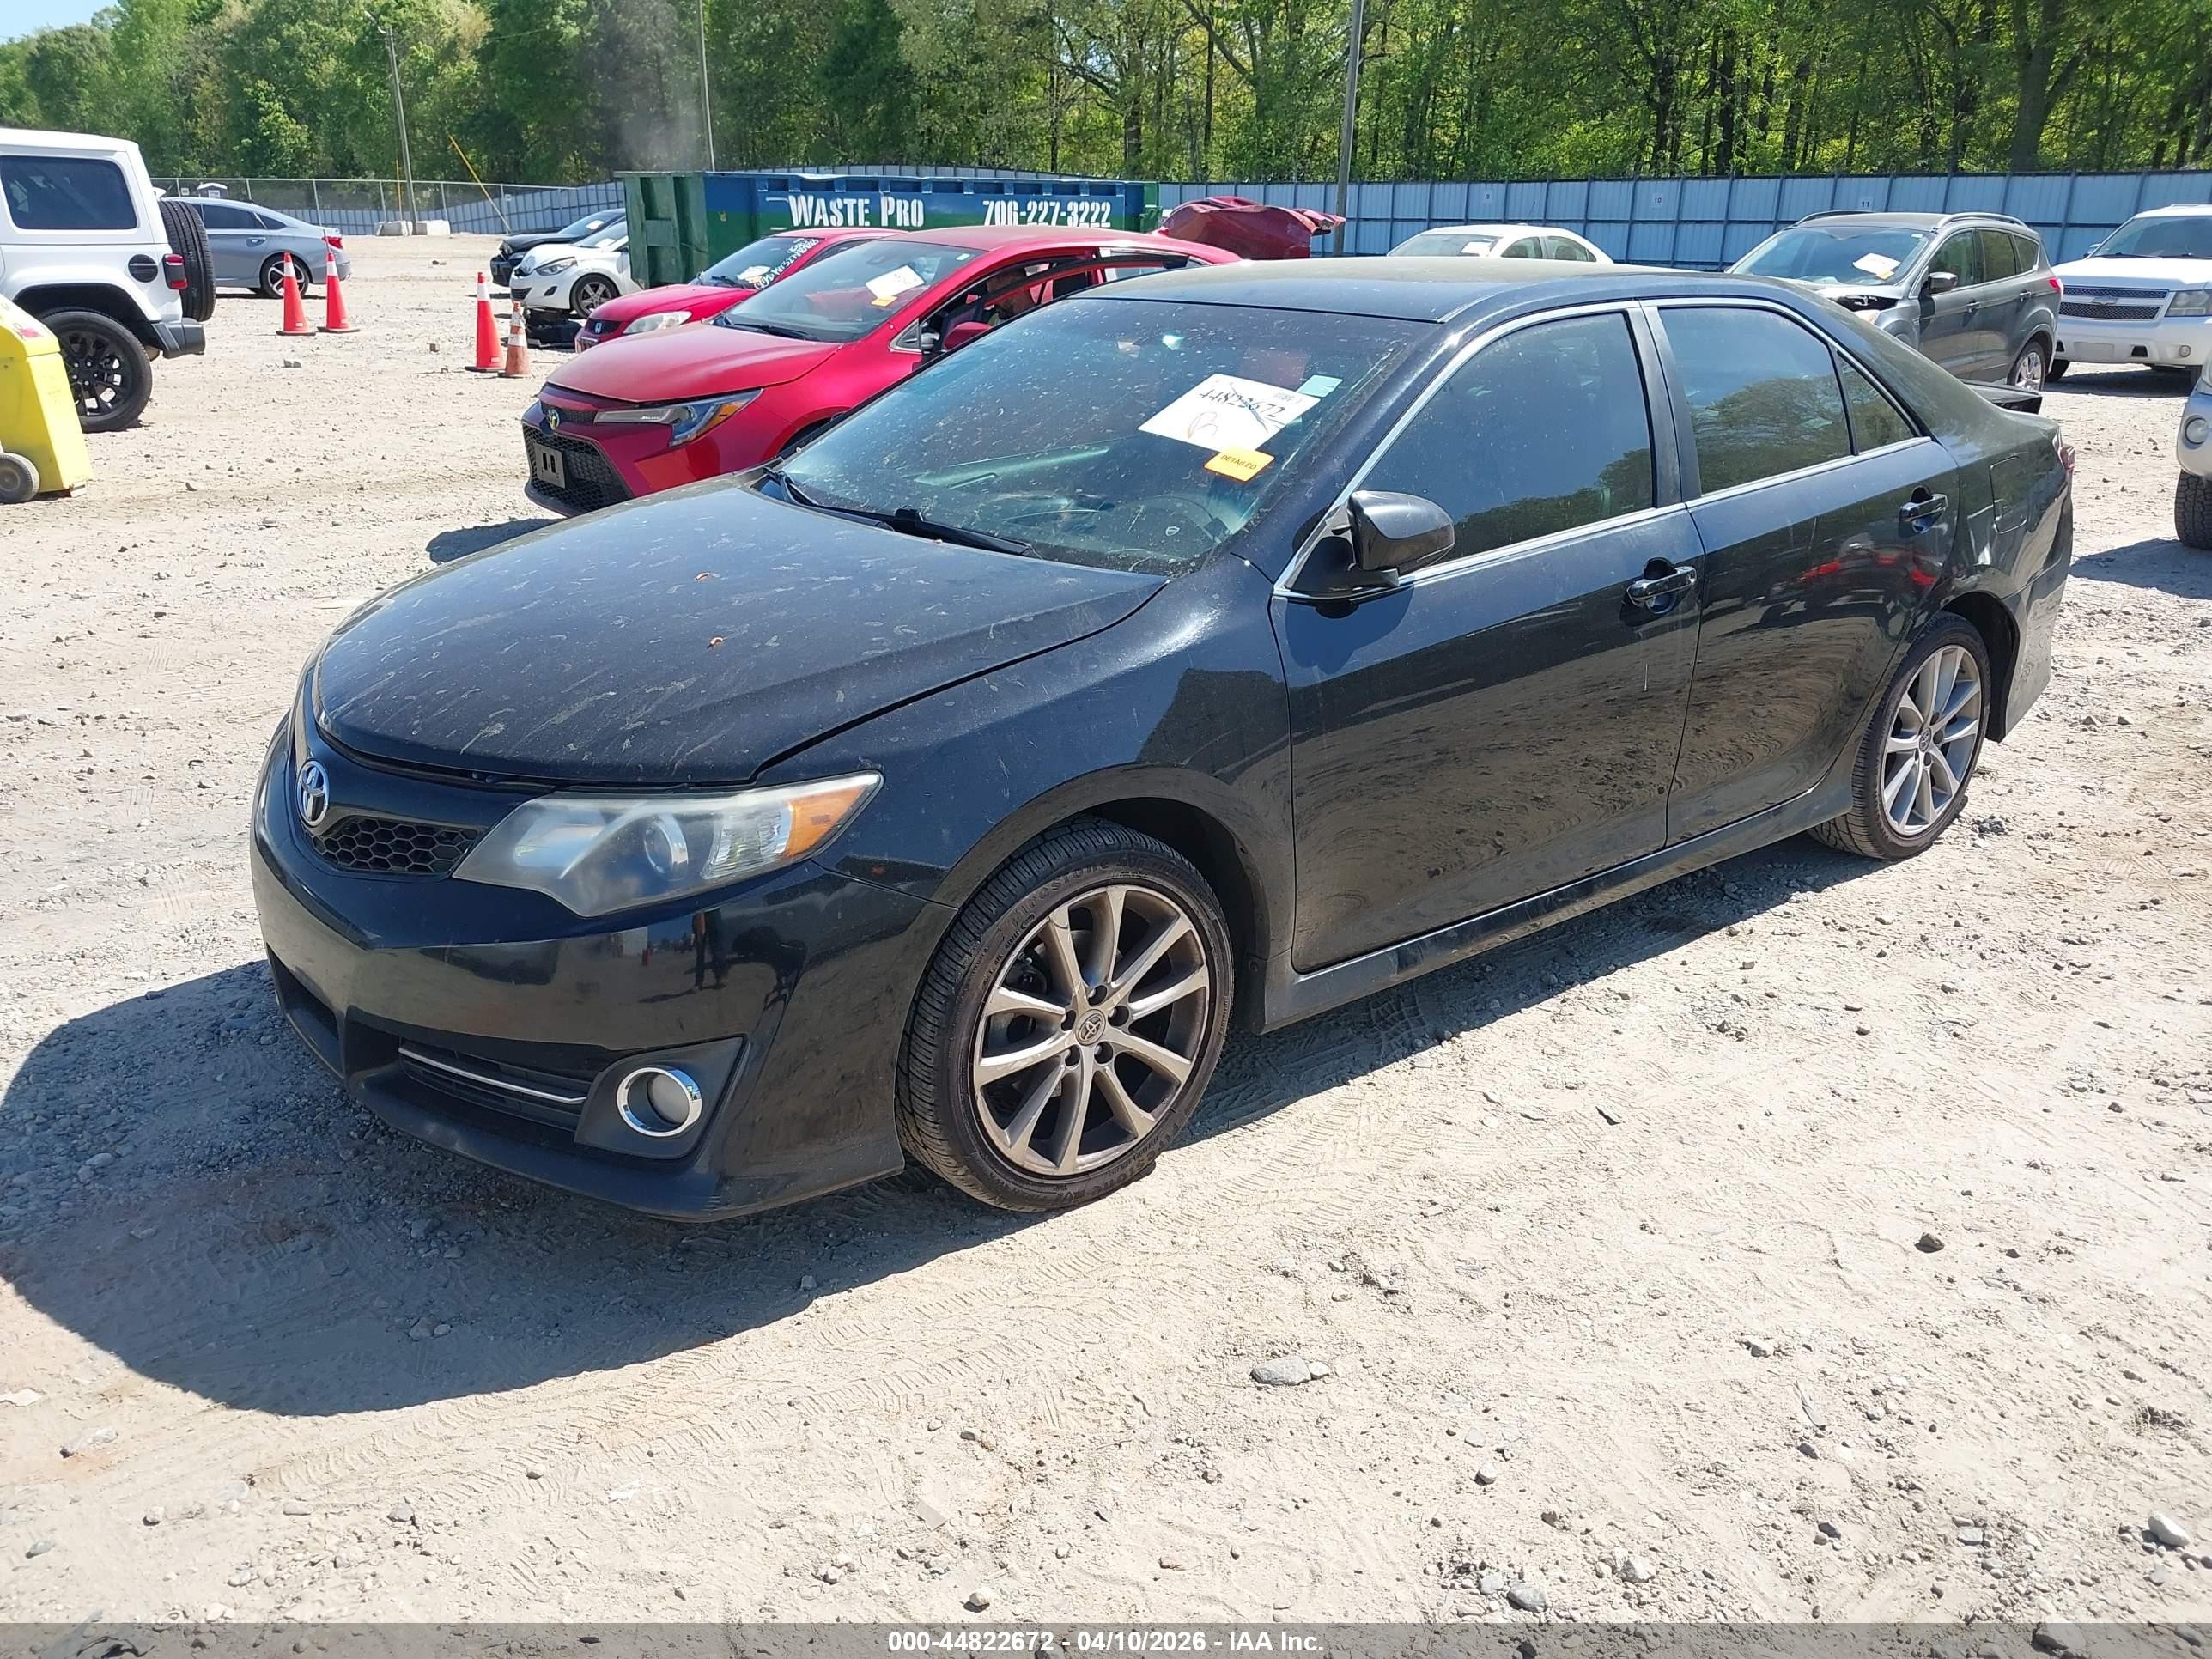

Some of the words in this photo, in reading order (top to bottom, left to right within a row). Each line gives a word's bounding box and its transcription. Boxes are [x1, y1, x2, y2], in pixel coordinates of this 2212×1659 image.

[788, 195, 871, 227] WASTE
[881, 195, 924, 227] PRO
[982, 199, 1111, 228] 706-227-3222
[1220, 454, 1257, 470] DETAILED
